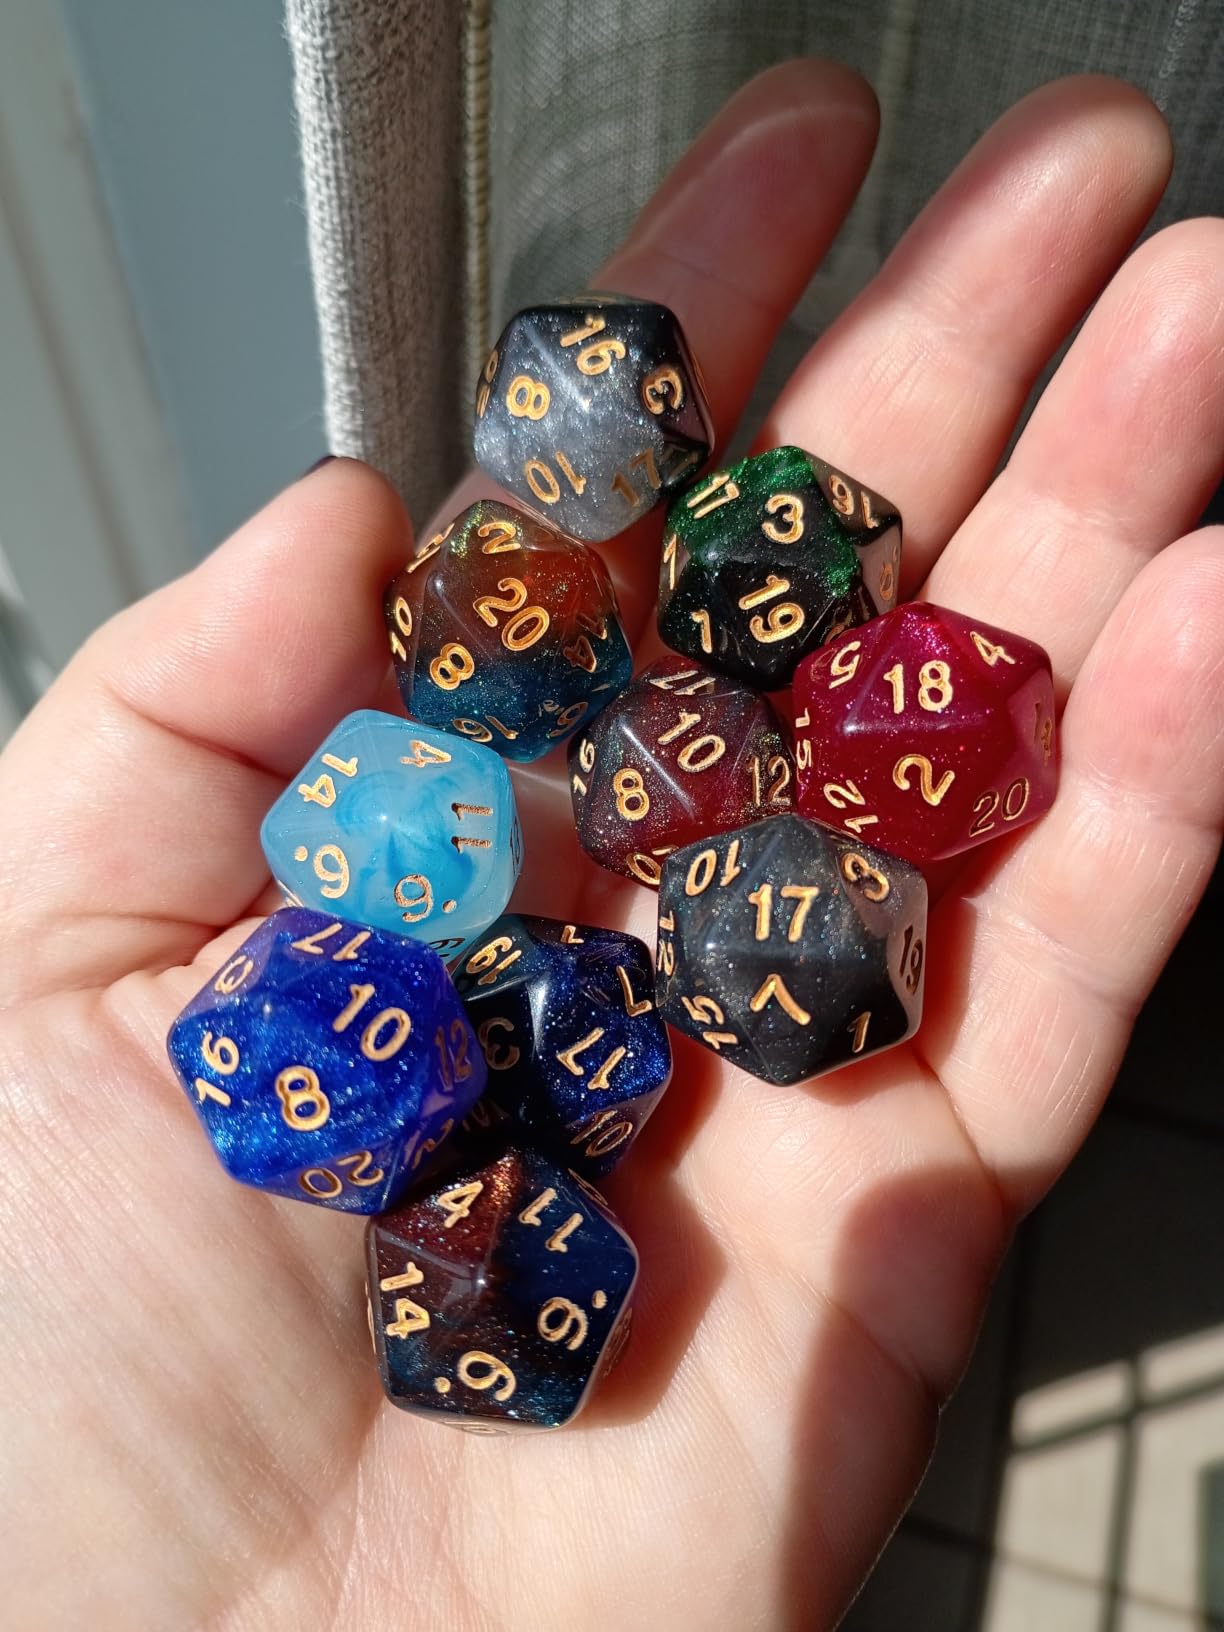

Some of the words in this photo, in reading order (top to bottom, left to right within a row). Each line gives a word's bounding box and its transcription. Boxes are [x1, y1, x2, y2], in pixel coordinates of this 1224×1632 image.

[559, 314, 627, 376] 16
[506, 374, 551, 420] 8
[642, 367, 684, 415] 3
[524, 449, 588, 504] 10
[611, 447, 662, 507] 17
[829, 474, 879, 529] 16
[478, 521, 521, 555] 2
[761, 493, 805, 545] 3
[390, 597, 413, 662] 10
[473, 577, 551, 652] 20
[691, 609, 713, 654] 1
[738, 574, 805, 644] 19
[429, 642, 474, 690] 8
[829, 641, 862, 689] 5
[969, 631, 1016, 668] 4
[883, 660, 954, 714] 18
[400, 740, 452, 768] 4
[453, 715, 518, 742] 16
[657, 711, 726, 772] 10
[297, 753, 358, 808] 14
[572, 738, 596, 796] 16
[747, 756, 791, 807] 12
[892, 753, 956, 806] 2
[613, 768, 650, 821] 8
[823, 779, 879, 834] 12
[969, 777, 1030, 838] 20
[626, 845, 680, 886] 0
[685, 839, 741, 898] 10
[842, 852, 890, 902] 3
[746, 883, 819, 943] 17
[291, 922, 371, 962] 17
[465, 936, 522, 986] 19
[657, 910, 676, 977] 12
[899, 925, 924, 996] 19
[214, 955, 254, 994] 3
[616, 965, 653, 1018] 7
[749, 973, 812, 1026] 7
[332, 984, 412, 1062] 10
[478, 1016, 521, 1071] 3
[680, 995, 740, 1051] 15
[846, 1011, 872, 1055] 1
[194, 1031, 240, 1107] 16
[433, 1019, 473, 1093] 12
[556, 1026, 627, 1090] 17
[274, 1065, 331, 1132] 8
[569, 1110, 634, 1157] 10
[300, 1149, 385, 1199] 20
[435, 1180, 485, 1229] 4
[519, 1188, 584, 1254] 11
[380, 1261, 431, 1340] 14
